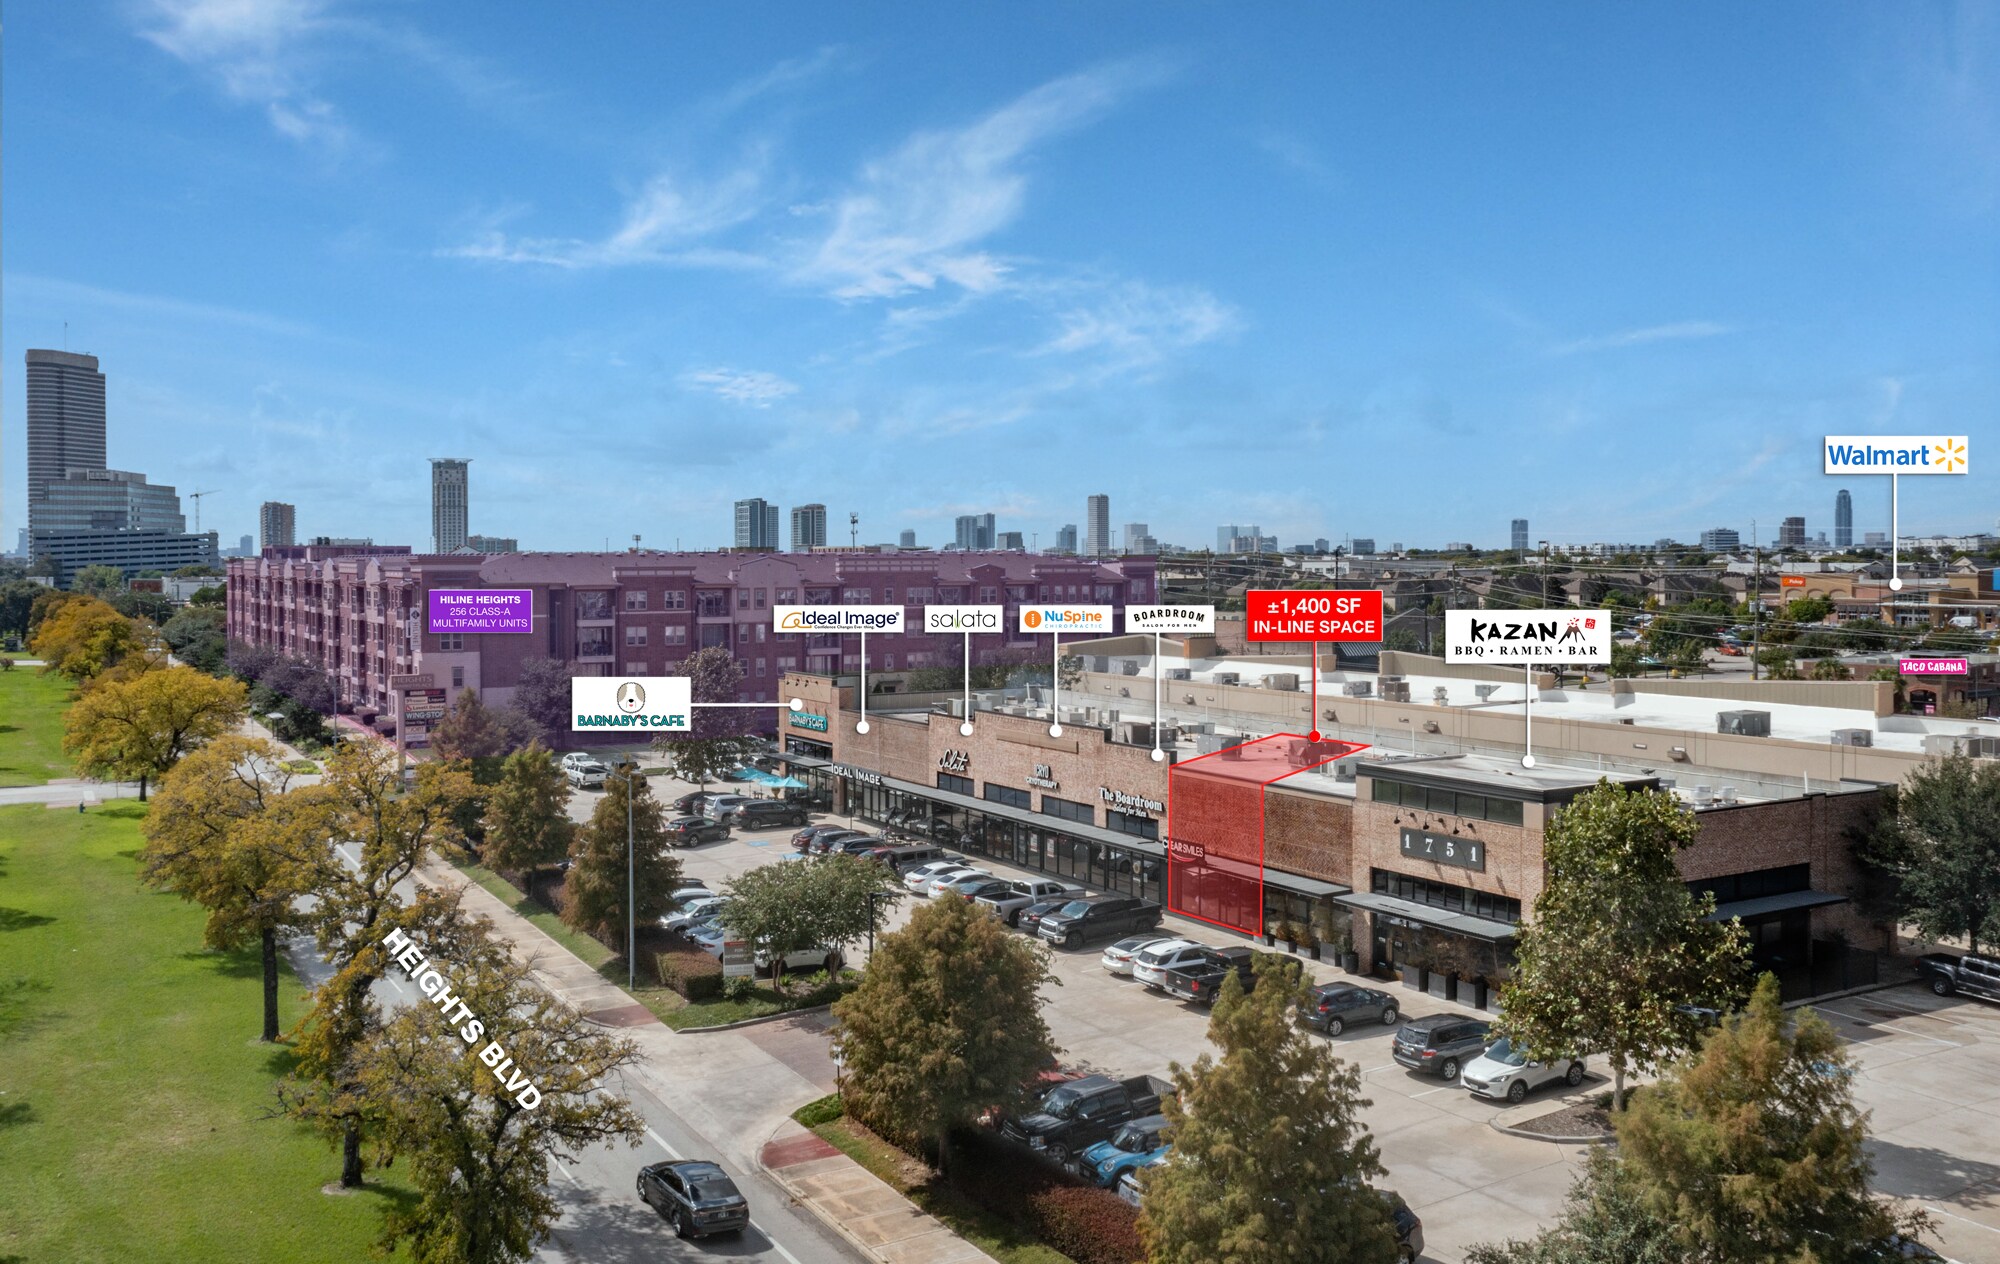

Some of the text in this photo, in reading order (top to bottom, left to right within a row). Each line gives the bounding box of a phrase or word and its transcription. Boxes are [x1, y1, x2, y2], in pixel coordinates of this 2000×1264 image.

[940, 749, 968, 771] Salata
[1099, 787, 1163, 812] The Boardroom
